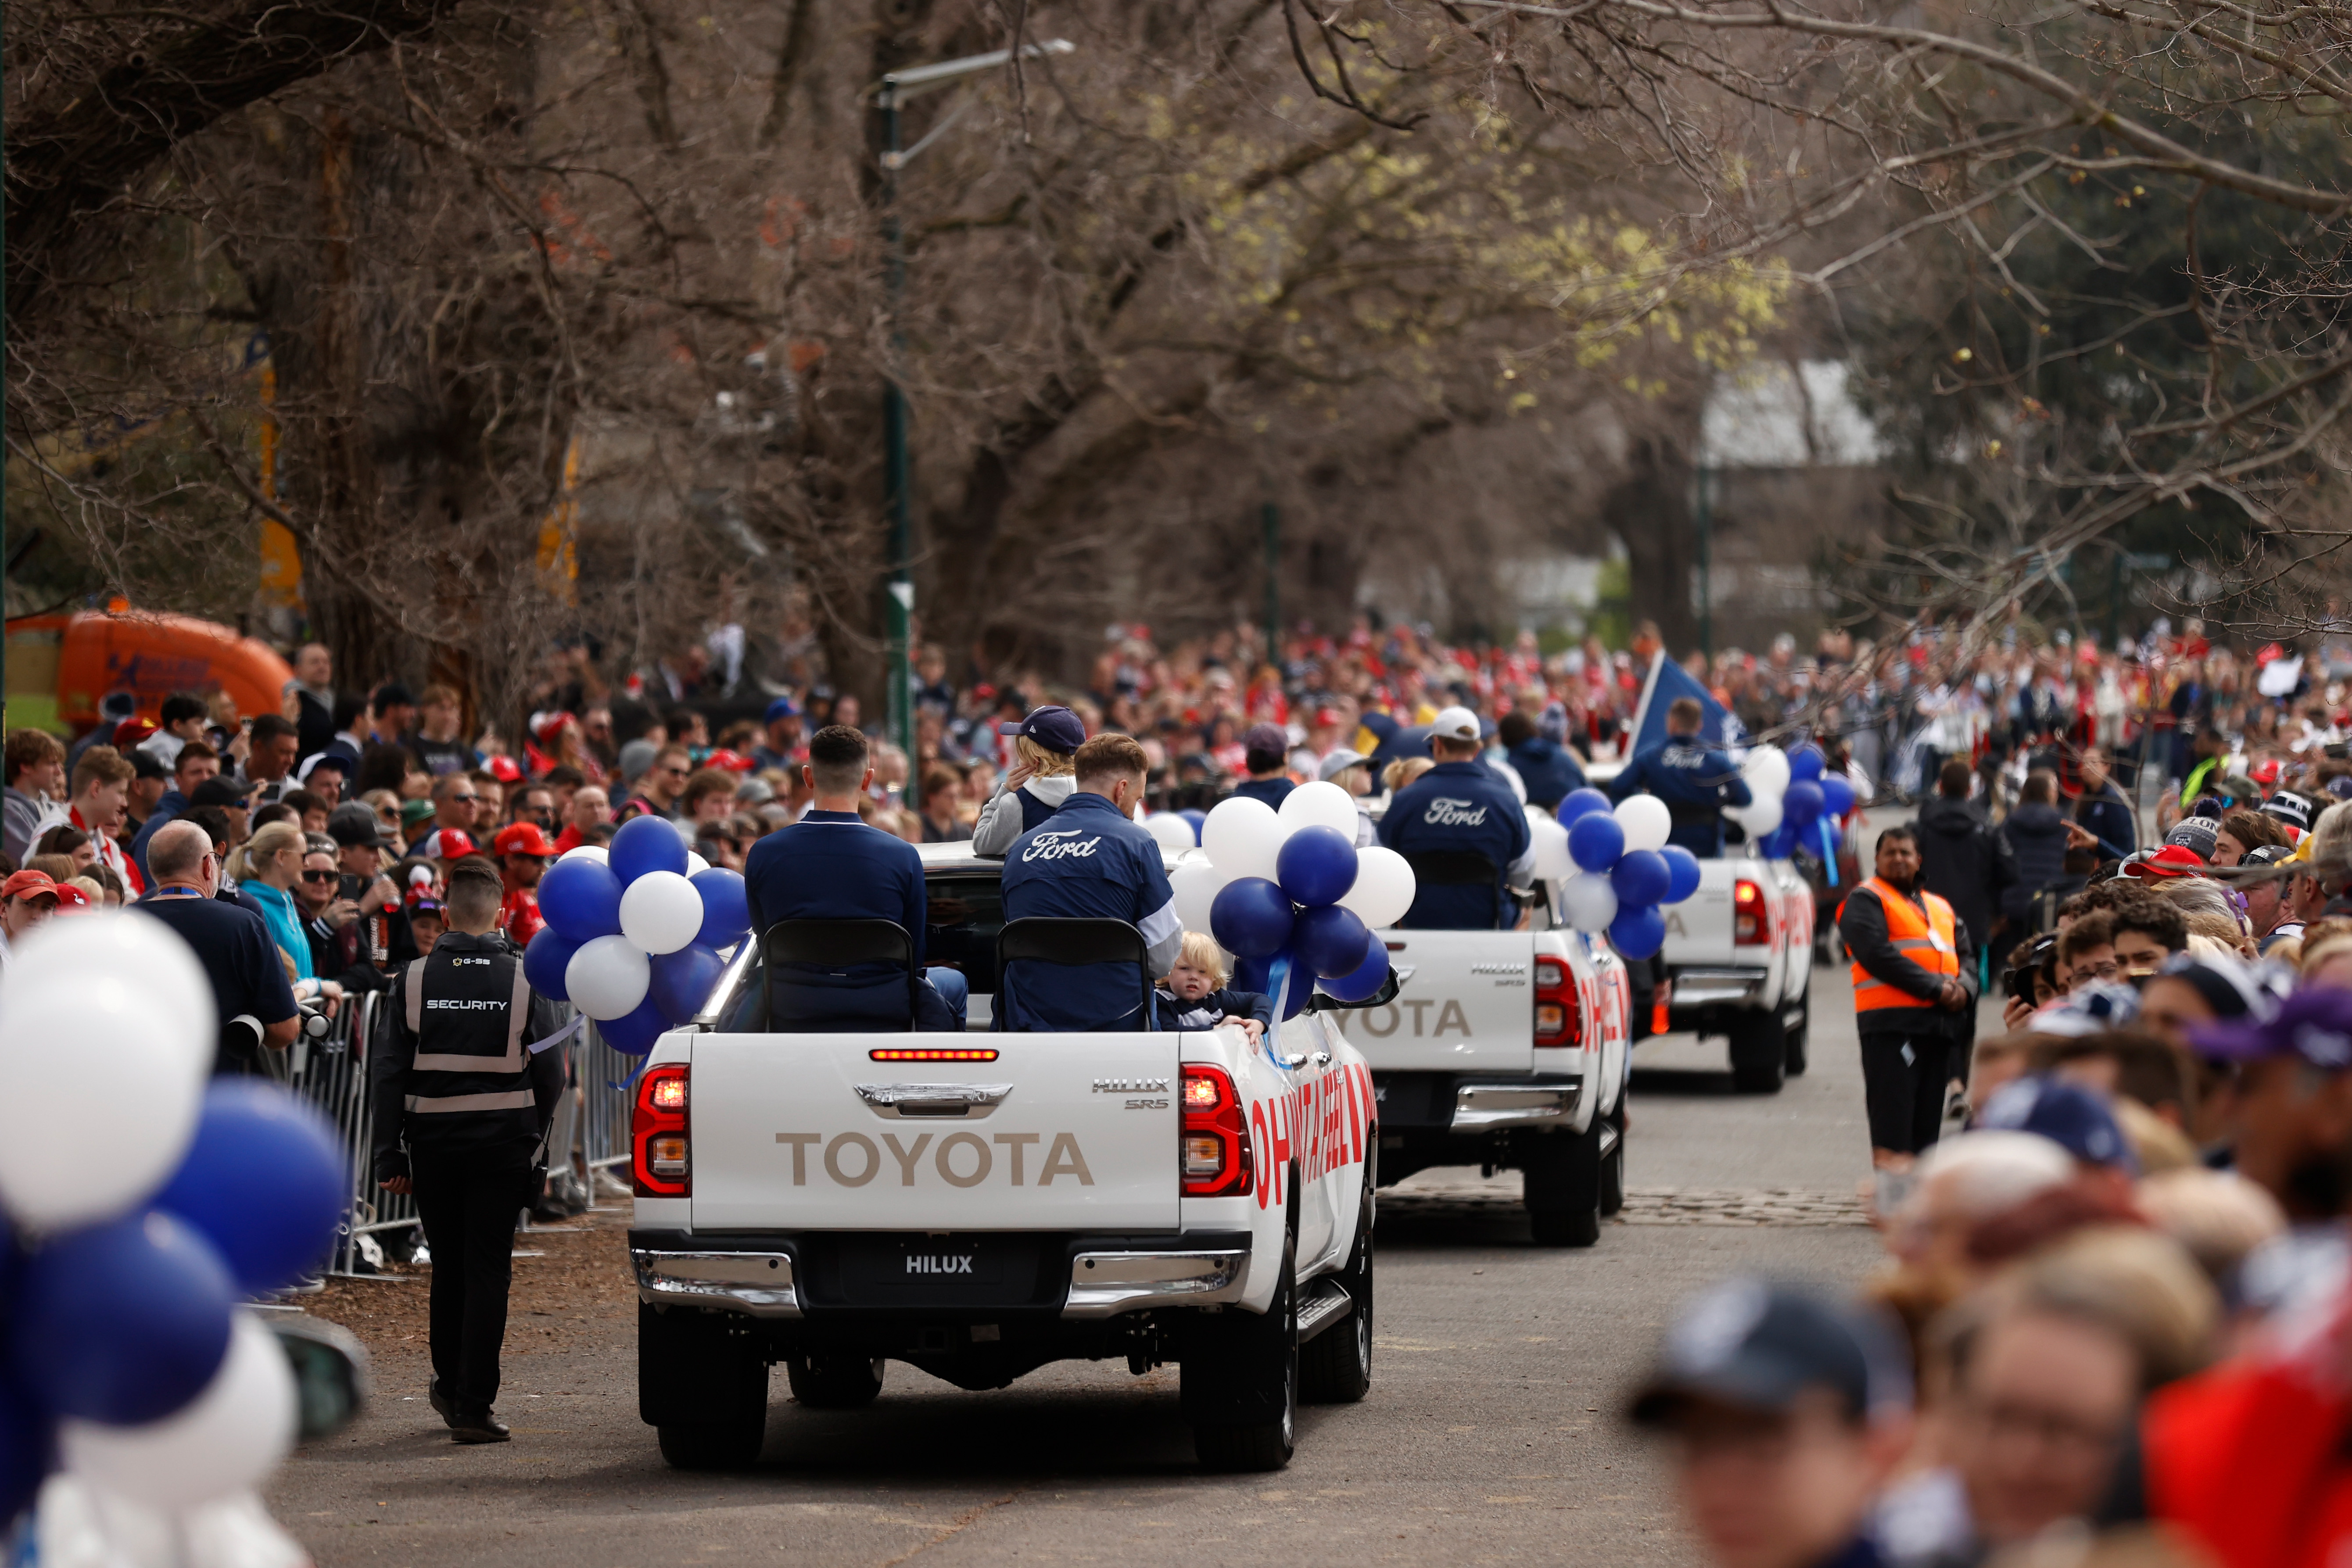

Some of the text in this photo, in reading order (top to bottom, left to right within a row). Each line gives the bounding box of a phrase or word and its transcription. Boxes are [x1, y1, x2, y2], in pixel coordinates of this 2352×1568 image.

[1660, 745, 1706, 770] Ford
[1423, 796, 1487, 827] Ford
[1022, 829, 1102, 863] Ford
[427, 999, 508, 1011] SECURITY
[1331, 999, 1473, 1038] YOTA
[1092, 1078, 1171, 1093] HILUX
[1124, 1099, 1169, 1109] SR5
[775, 1131, 1095, 1188] TOYOTA
[906, 1254, 973, 1274] HILUX
